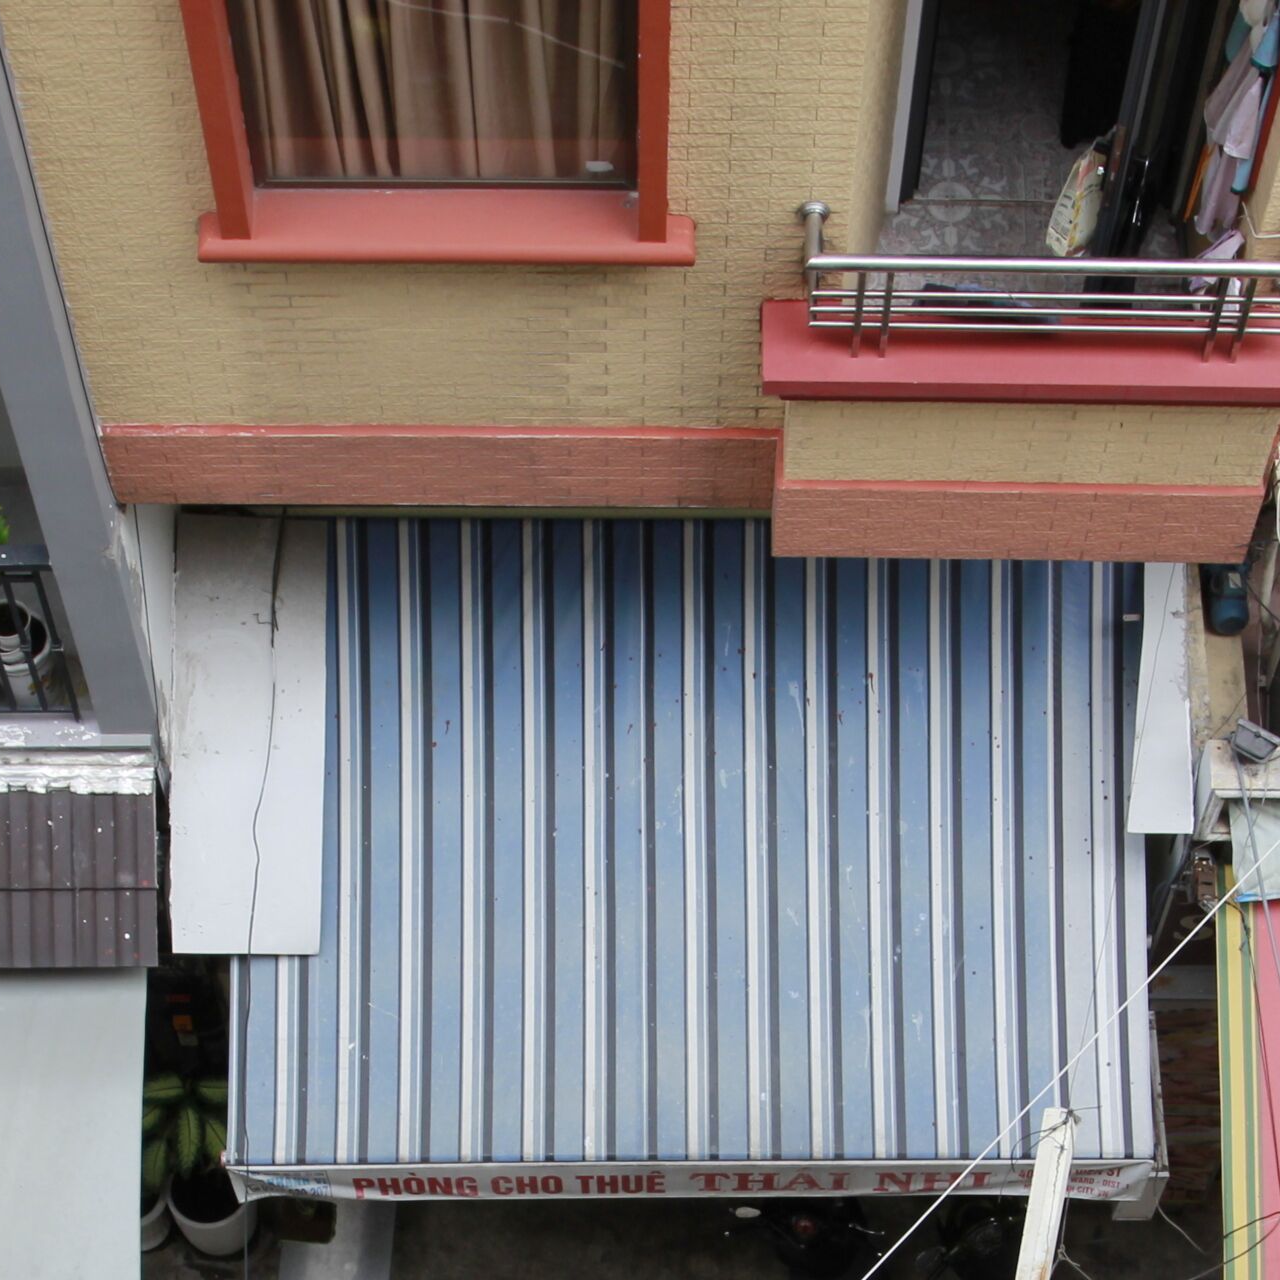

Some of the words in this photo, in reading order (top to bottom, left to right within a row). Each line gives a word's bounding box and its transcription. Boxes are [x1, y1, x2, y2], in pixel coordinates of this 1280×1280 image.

[352, 1172, 479, 1200] PHÒNG
[491, 1175, 564, 1196] CHO
[575, 1171, 667, 1195] THUÊ
[873, 1171, 993, 1193] NHI
